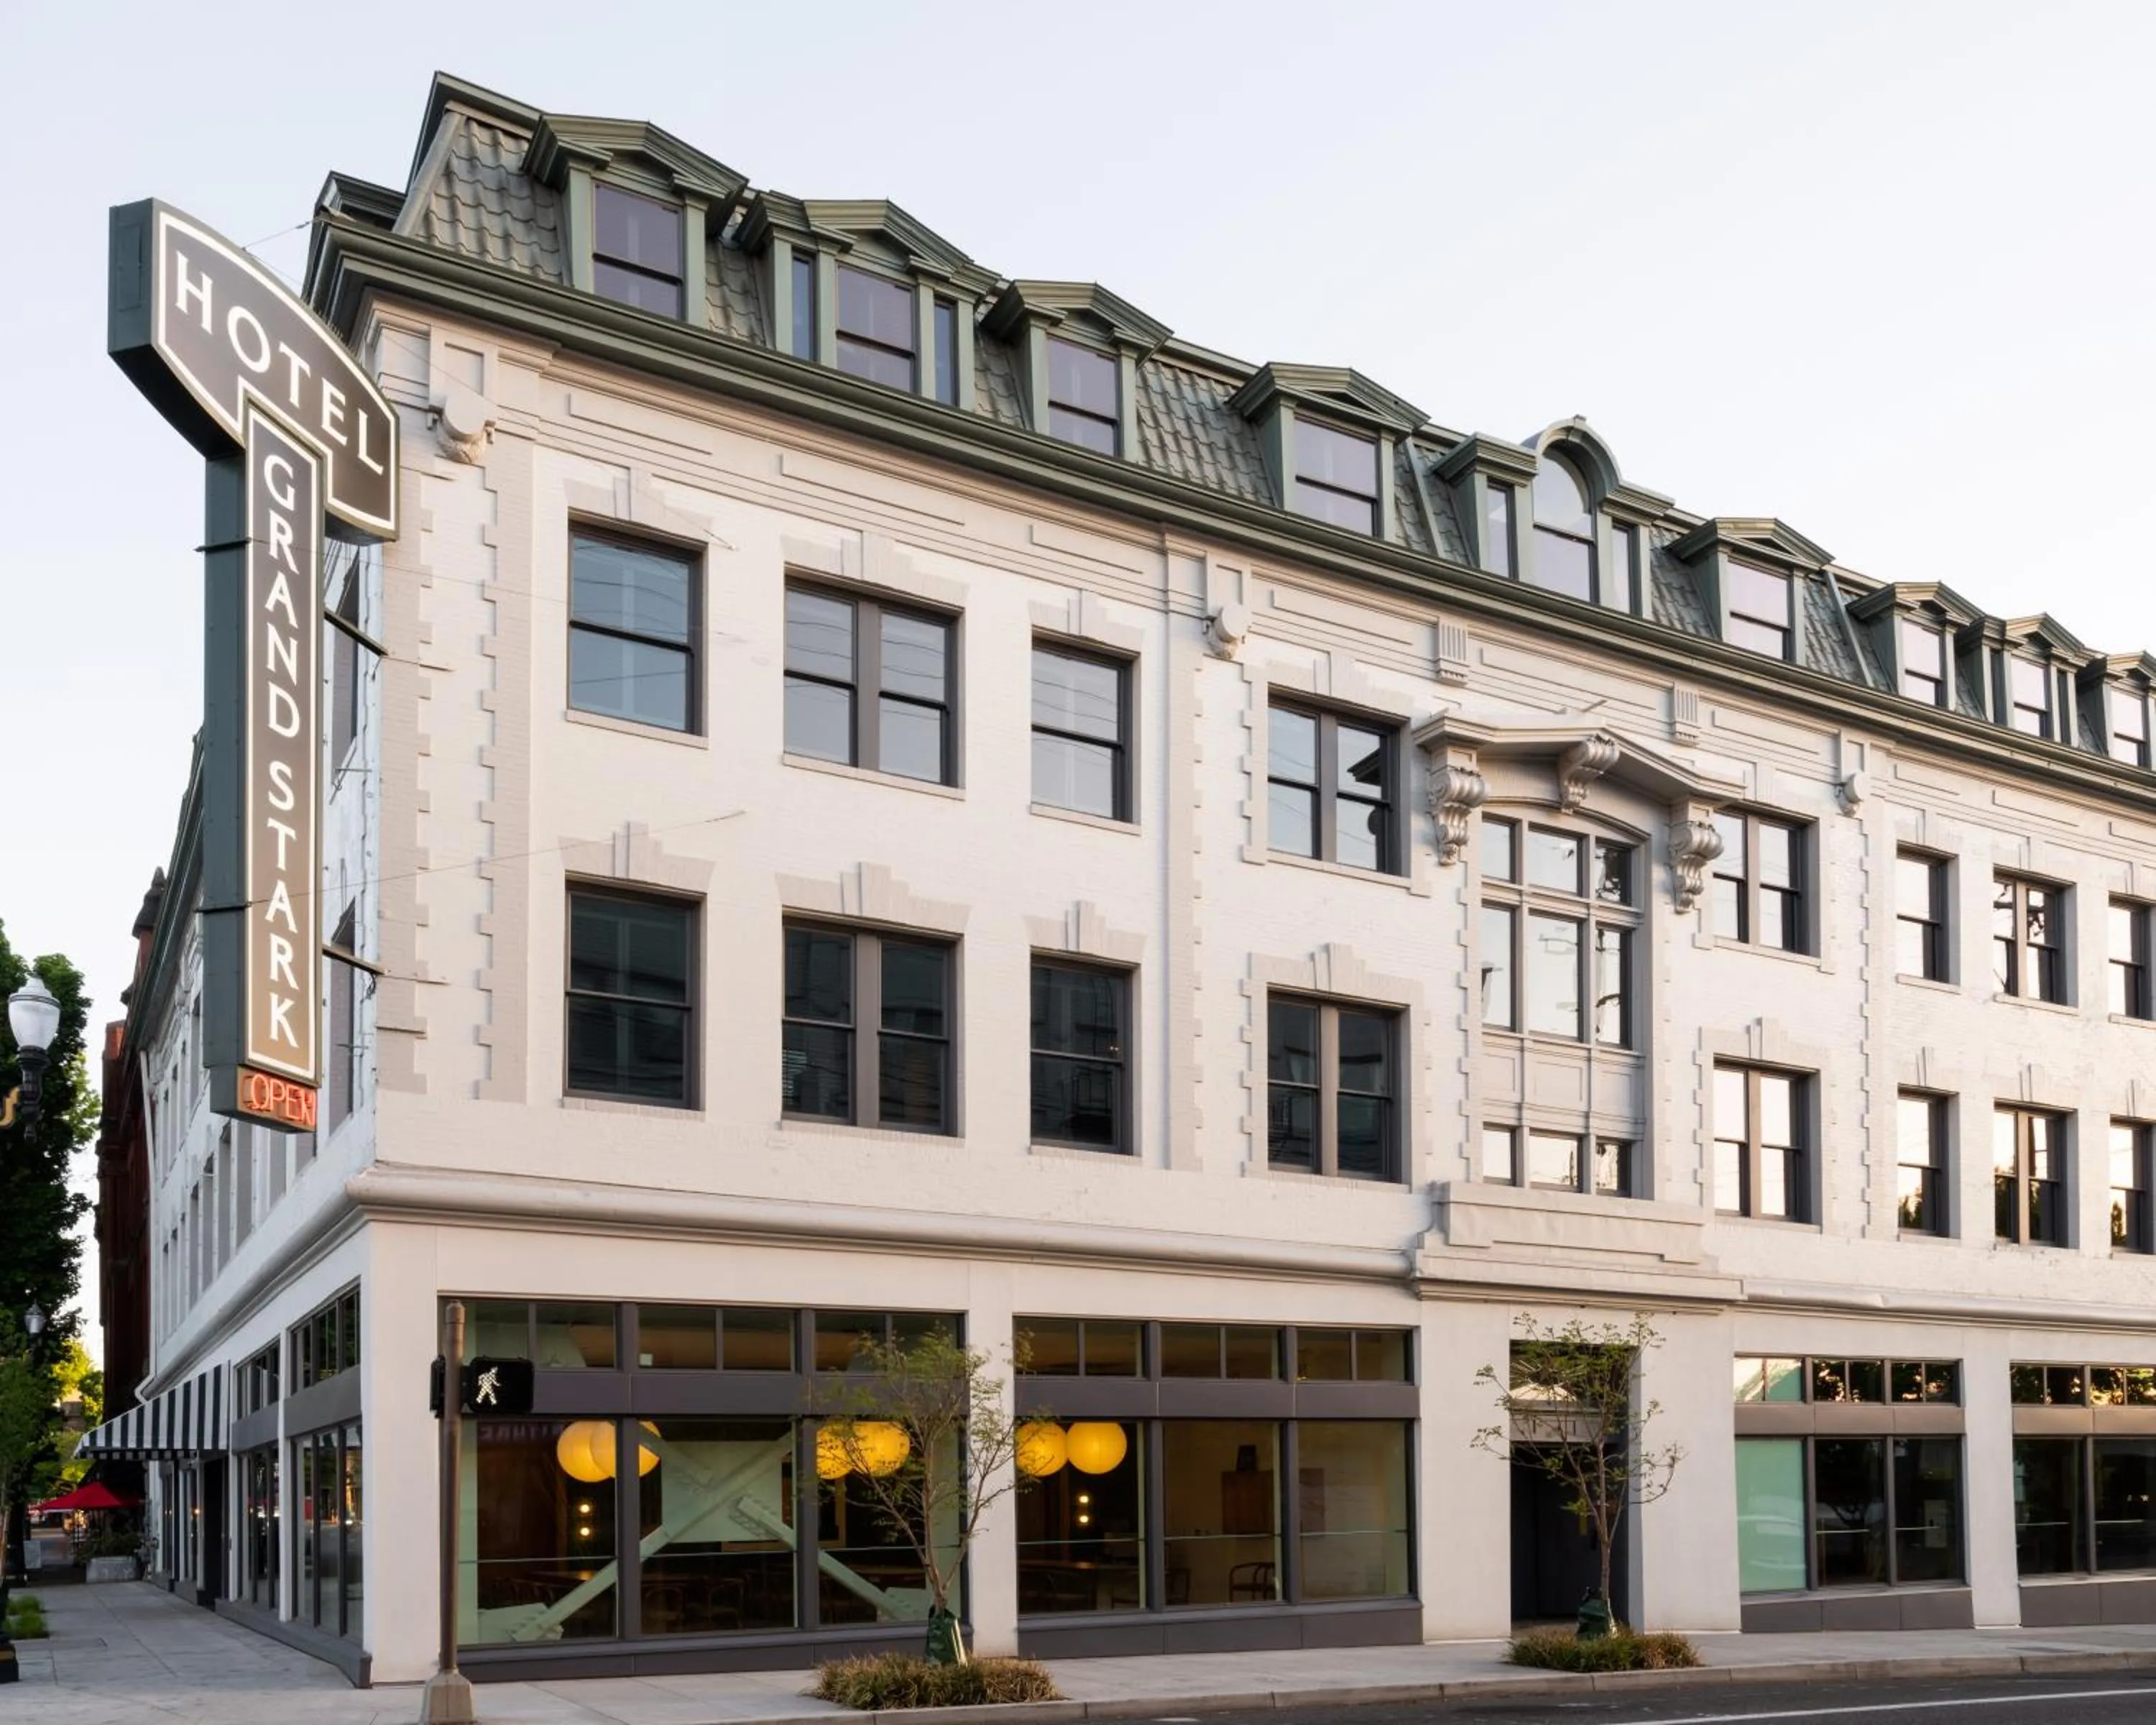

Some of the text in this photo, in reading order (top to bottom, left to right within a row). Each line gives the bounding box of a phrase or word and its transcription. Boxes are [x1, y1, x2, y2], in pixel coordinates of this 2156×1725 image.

[175, 250, 384, 475] HOTEL
[263, 454, 300, 1049] GRAND STARK
[249, 1073, 316, 1127] OPEN
